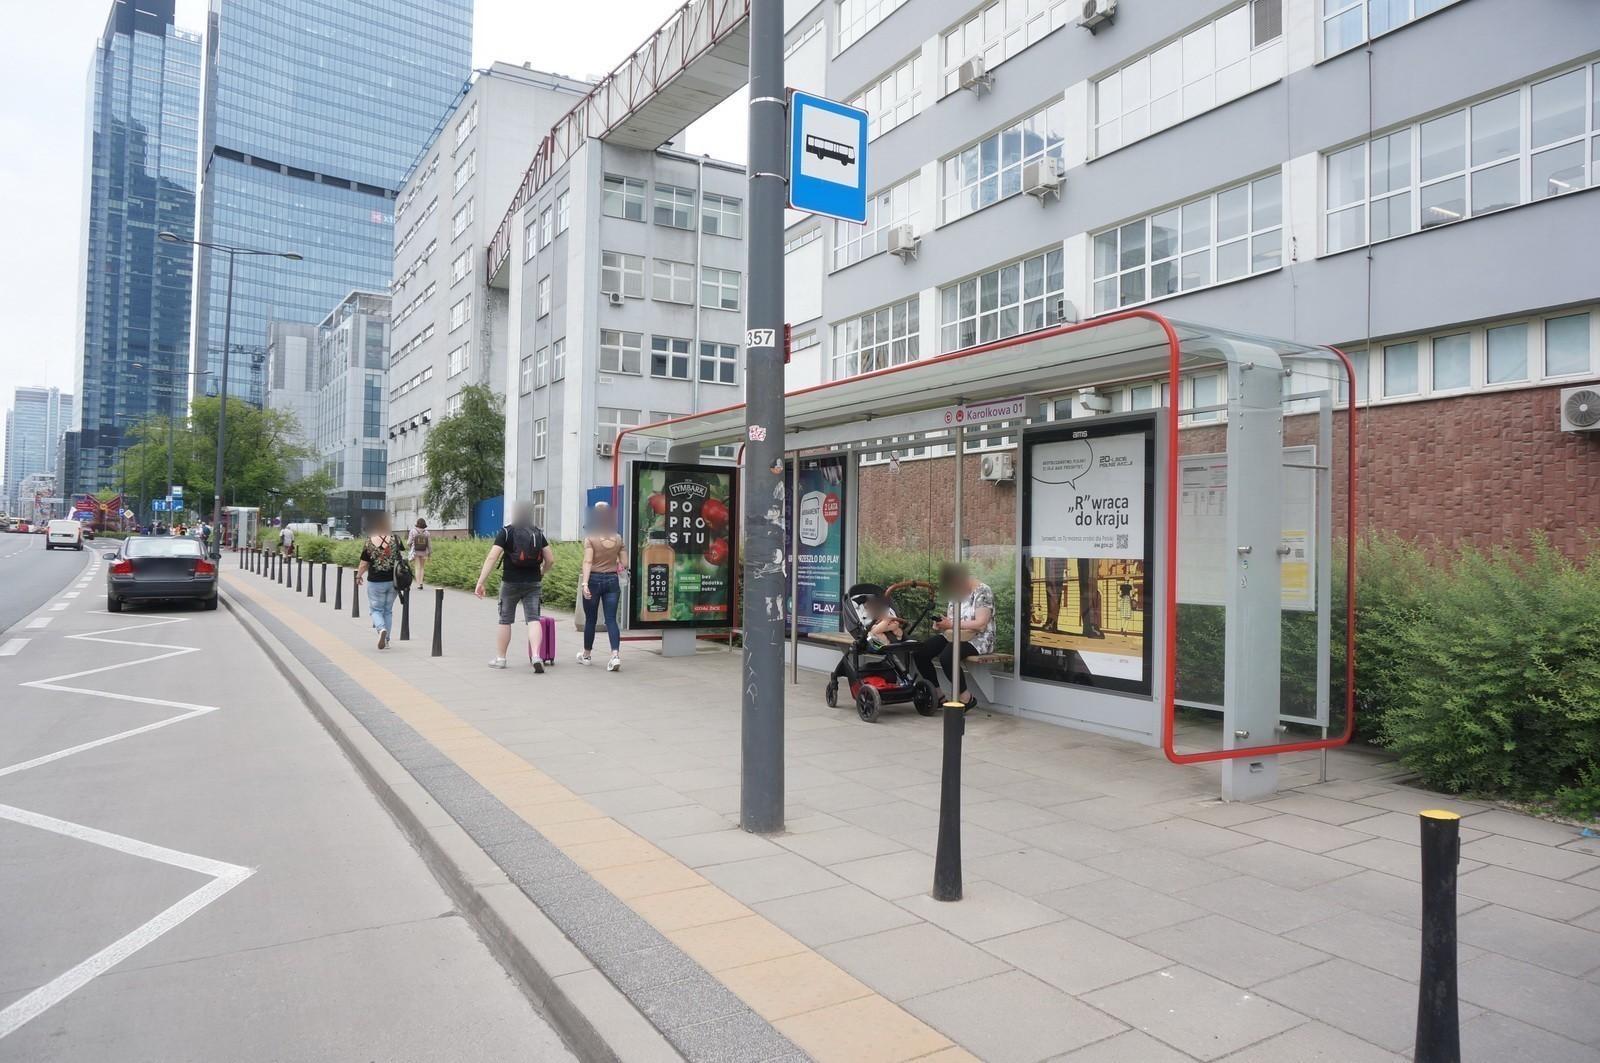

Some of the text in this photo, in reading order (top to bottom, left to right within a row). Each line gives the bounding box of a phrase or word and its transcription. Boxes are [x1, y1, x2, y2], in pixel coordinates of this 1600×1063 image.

[747, 330, 773, 347] 357
[966, 406, 1010, 421] Karolkowa
[1012, 403, 1023, 414] 01
[671, 484, 705, 496] TYMBARK
[670, 500, 693, 513] PO
[1091, 497, 1129, 511] wraca
[670, 516, 706, 529] PRO
[1075, 510, 1129, 529] do kraju
[669, 531, 705, 544] STU
[819, 555, 827, 564] DO
[827, 555, 840, 564] PLAY
[813, 603, 836, 613] PLAY
